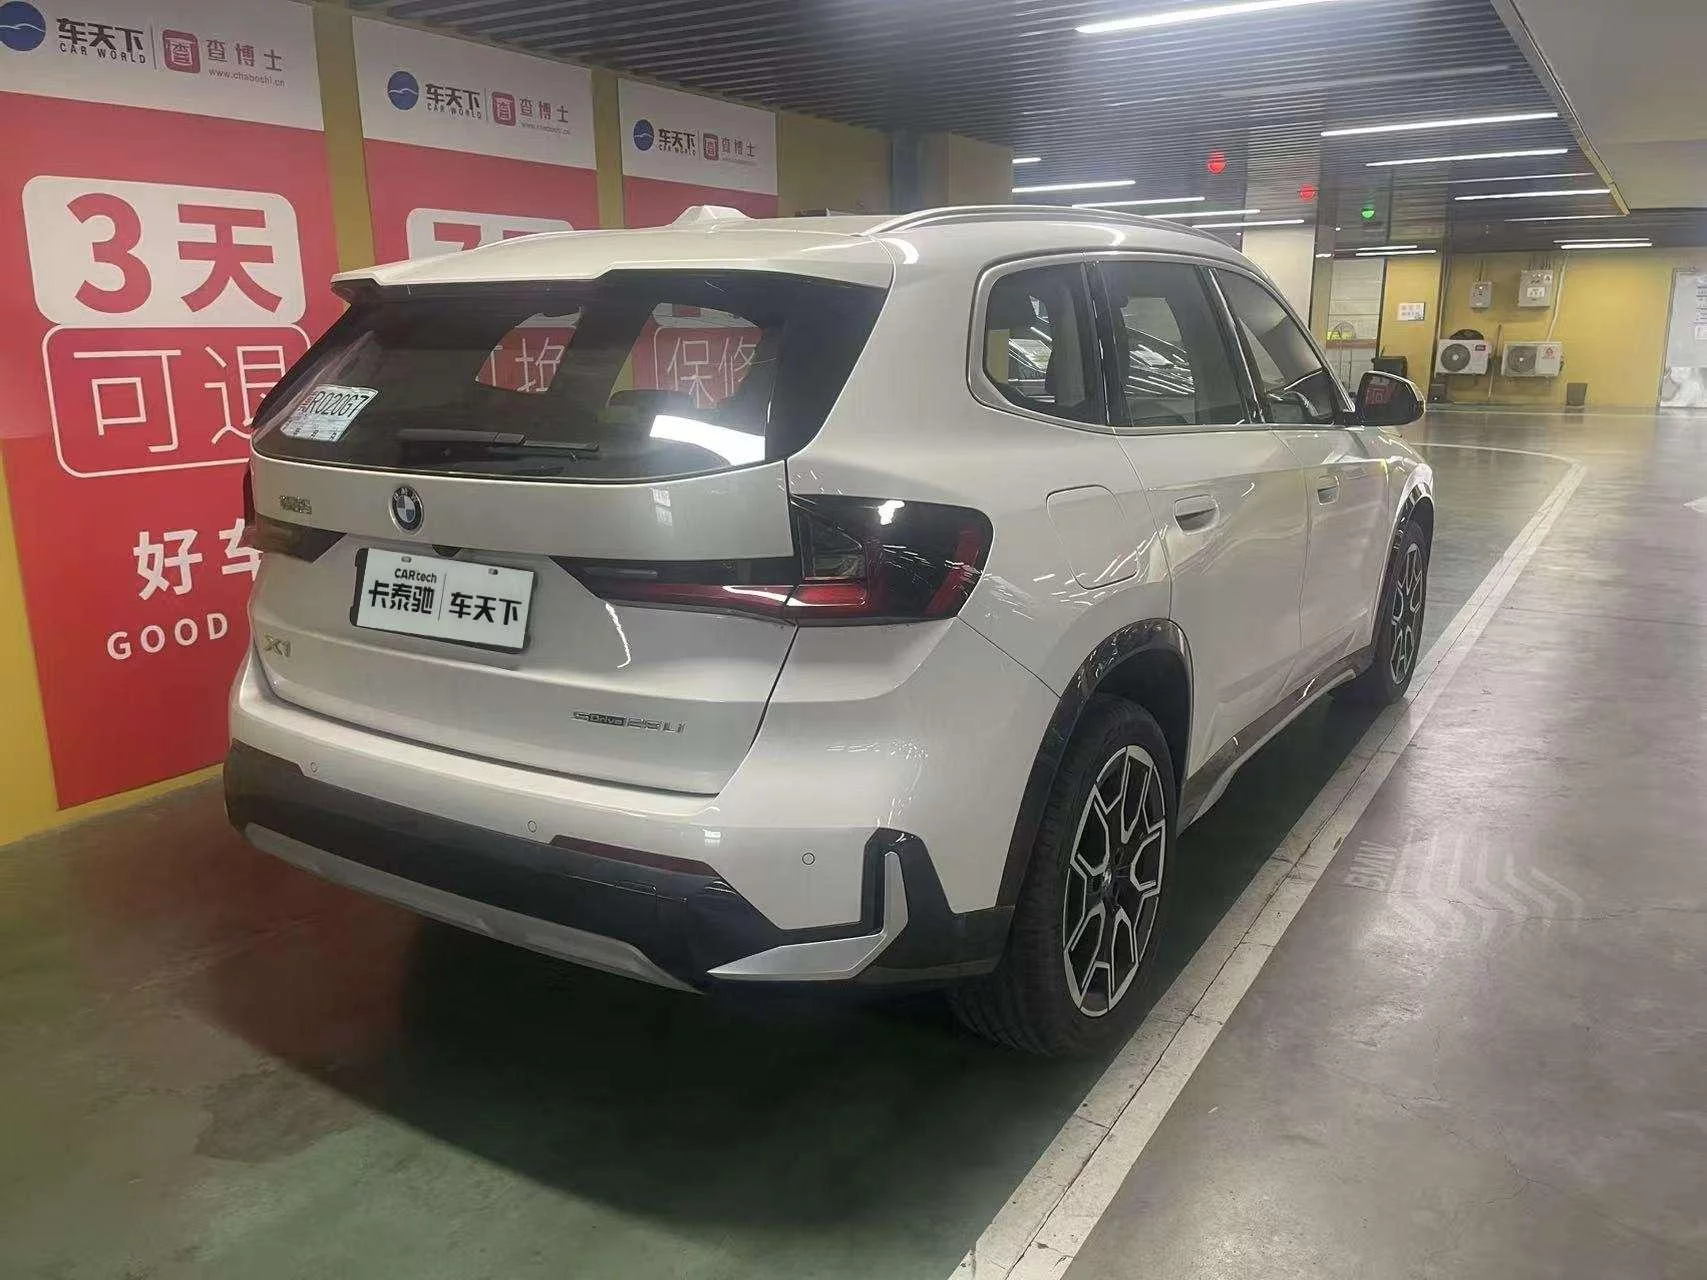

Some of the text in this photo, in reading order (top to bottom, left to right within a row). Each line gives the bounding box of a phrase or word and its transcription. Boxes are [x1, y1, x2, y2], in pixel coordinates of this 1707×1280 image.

[57, 18, 144, 53] 车天下
[60, 43, 145, 64] CAR WORLD
[206, 39, 283, 71] 查博士
[426, 84, 481, 111] 车天下
[427, 103, 482, 119] CAR WORLD
[519, 98, 570, 123] 查博士
[658, 129, 696, 149] 车天下
[67, 192, 284, 314] 3天
[368, 580, 522, 626] 卡泰驰 车天下
[107, 612, 228, 660] GOOD
